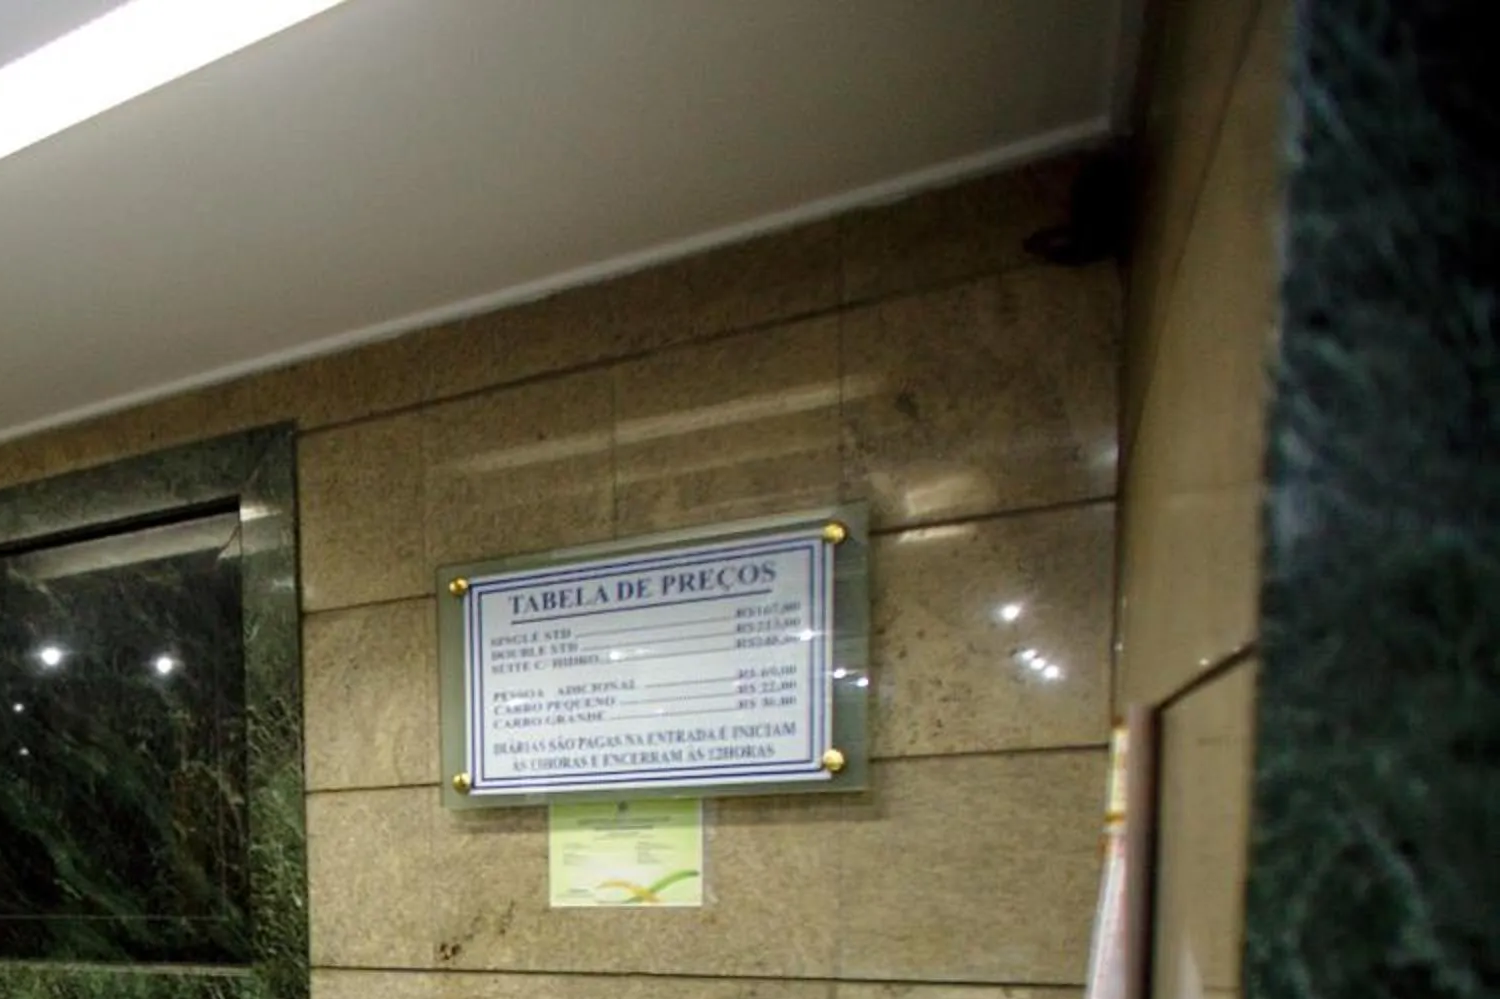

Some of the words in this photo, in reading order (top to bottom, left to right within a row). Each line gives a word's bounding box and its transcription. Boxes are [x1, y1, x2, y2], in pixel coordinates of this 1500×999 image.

[508, 585, 611, 616] TABELA
[615, 577, 653, 602] DE
[662, 560, 778, 597] PREÇOS
[493, 702, 543, 717] CARRO
[547, 696, 617, 712] PEQUENO
[493, 715, 543, 731] CARRO
[545, 710, 607, 727] GRANDE
[548, 735, 575, 752] SÃO
[647, 726, 716, 746] ENTRADA
[732, 720, 798, 741] INICIAM
[602, 747, 684, 767] ENCERRAM
